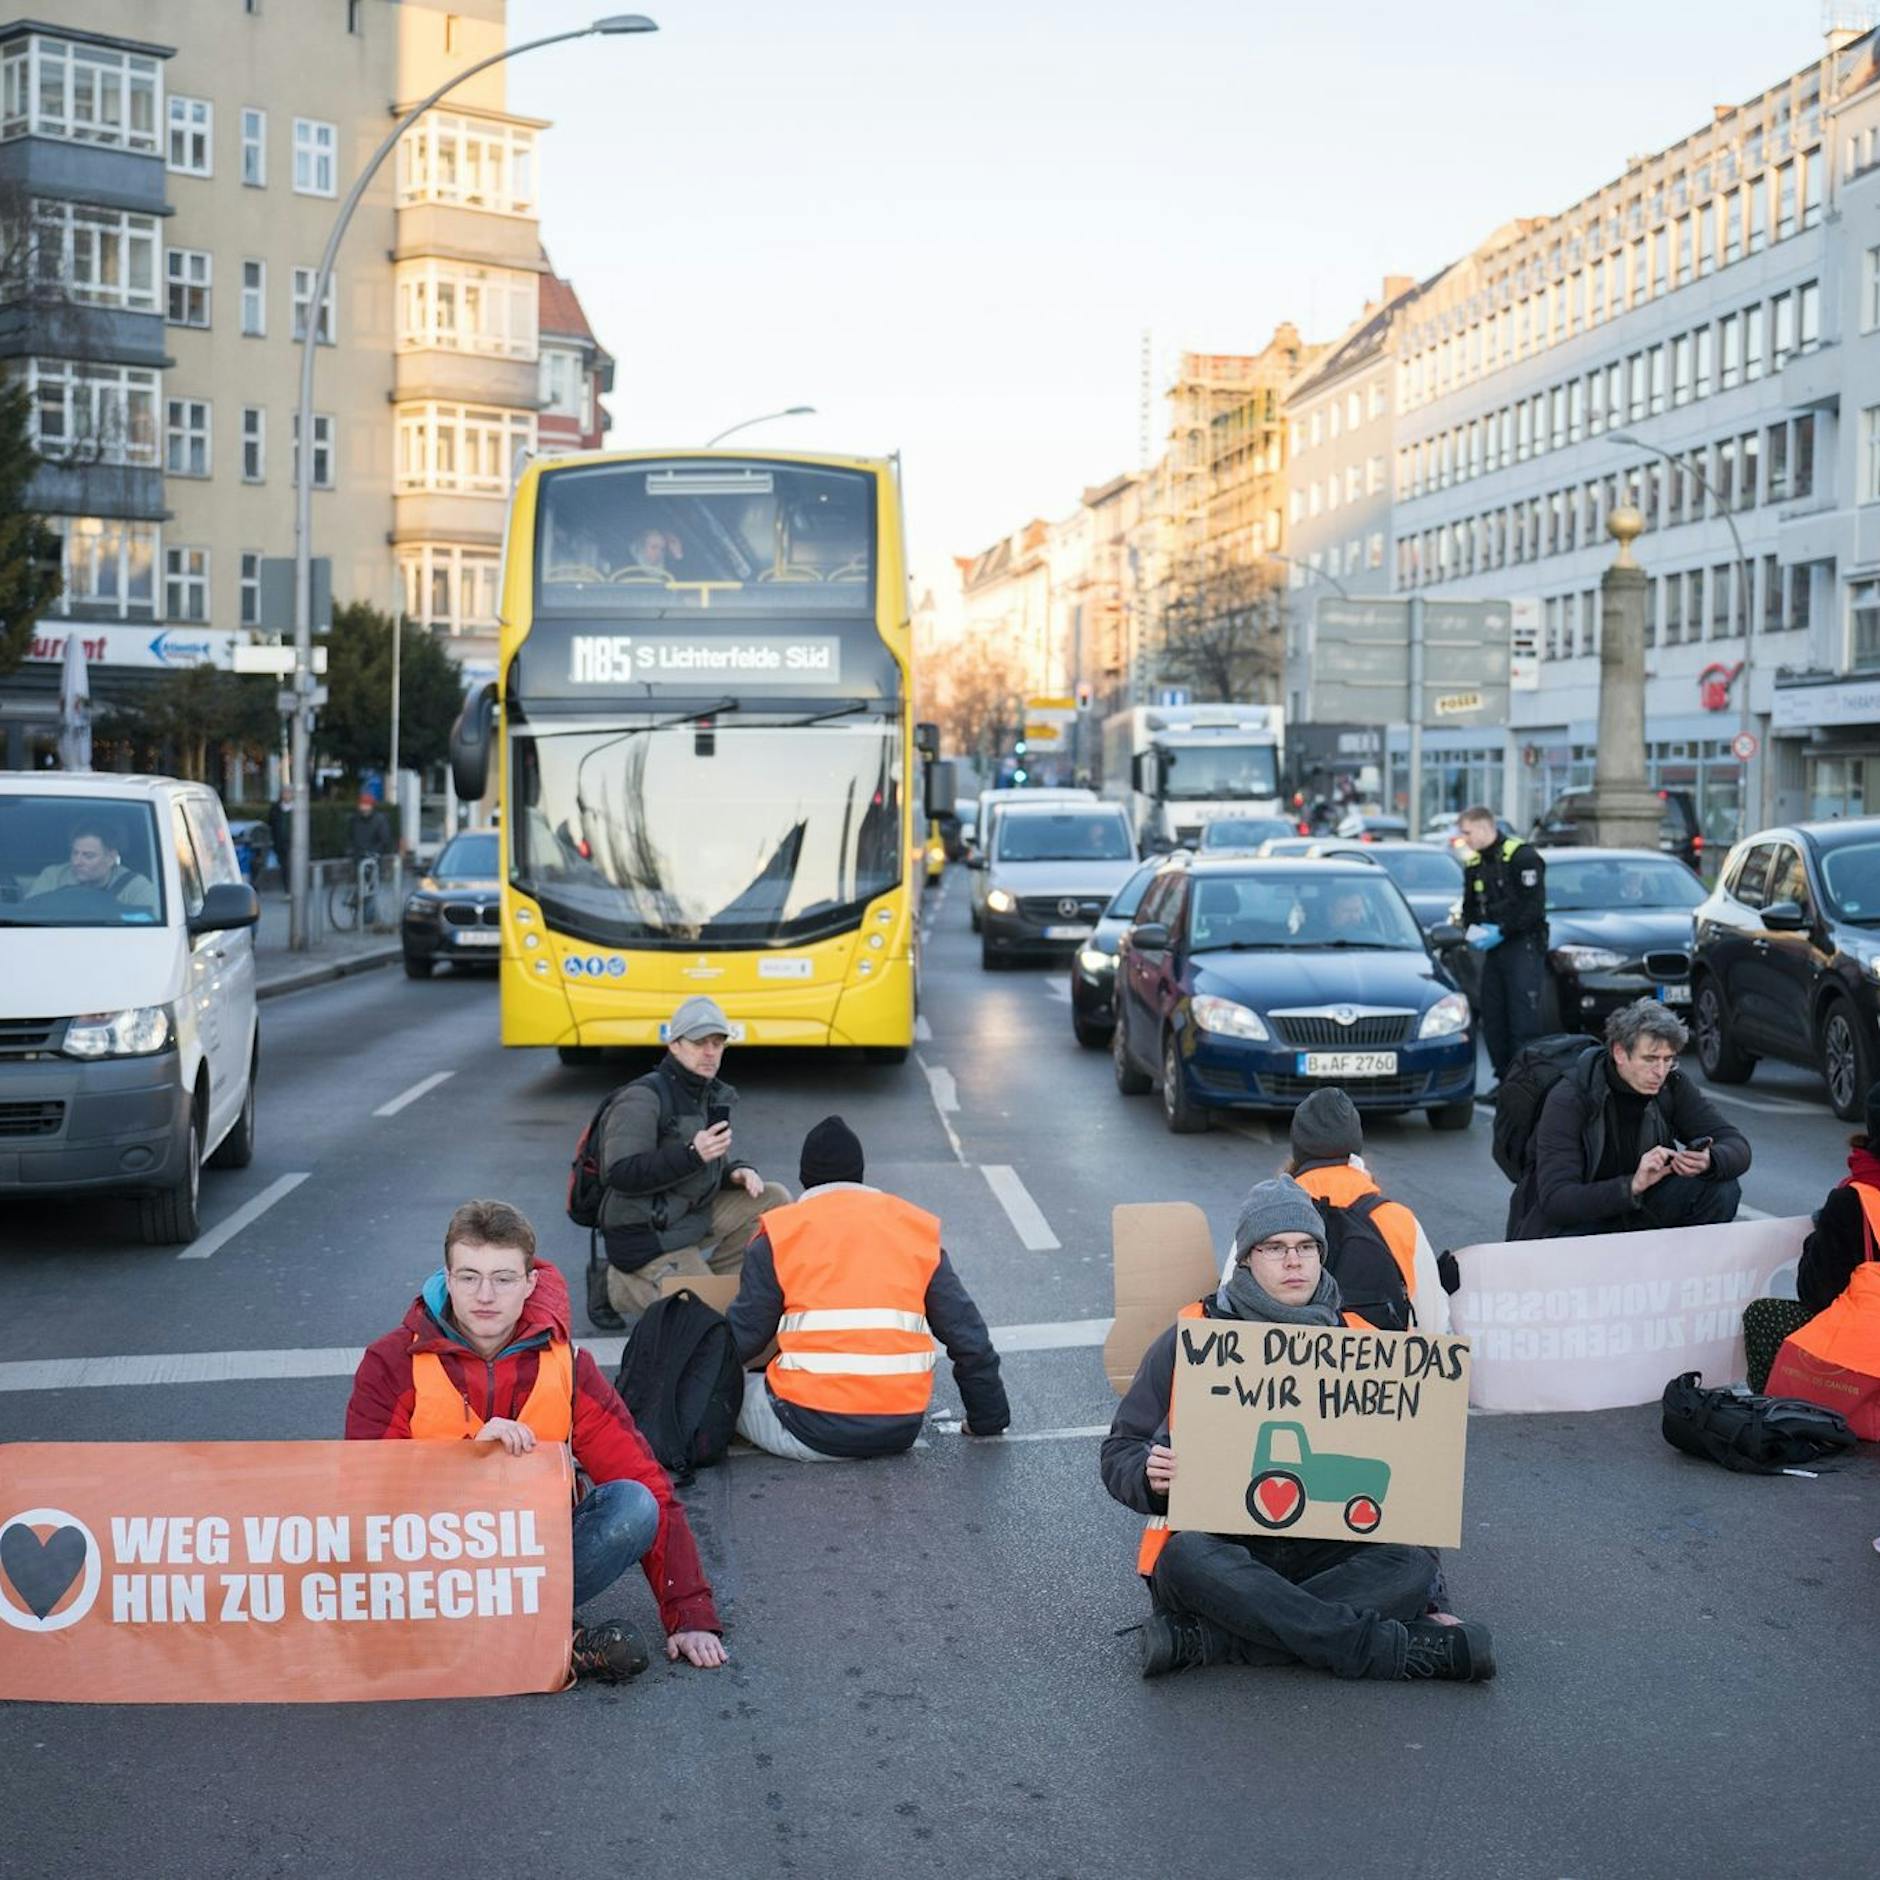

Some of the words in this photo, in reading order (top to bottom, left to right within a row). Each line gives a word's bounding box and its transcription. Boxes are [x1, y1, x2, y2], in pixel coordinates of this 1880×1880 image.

[573, 636, 631, 682] M85
[636, 646, 655, 668] S
[660, 645, 780, 668] Lichterfelde
[786, 645, 829, 668] Süd
[1355, 1055, 1395, 1071] 2760
[1181, 1328, 1245, 1367] WIR
[1264, 1328, 1397, 1373] DÜRFEN
[1403, 1335, 1471, 1381] DAS
[1318, 1377, 1421, 1421] HABEN
[110, 1516, 231, 1565] WEG
[243, 1515, 351, 1564] VON
[365, 1509, 546, 1563] FOSSIL
[112, 1574, 207, 1624] HIN
[219, 1573, 286, 1623] ZU
[301, 1566, 547, 1621] GERECHT
